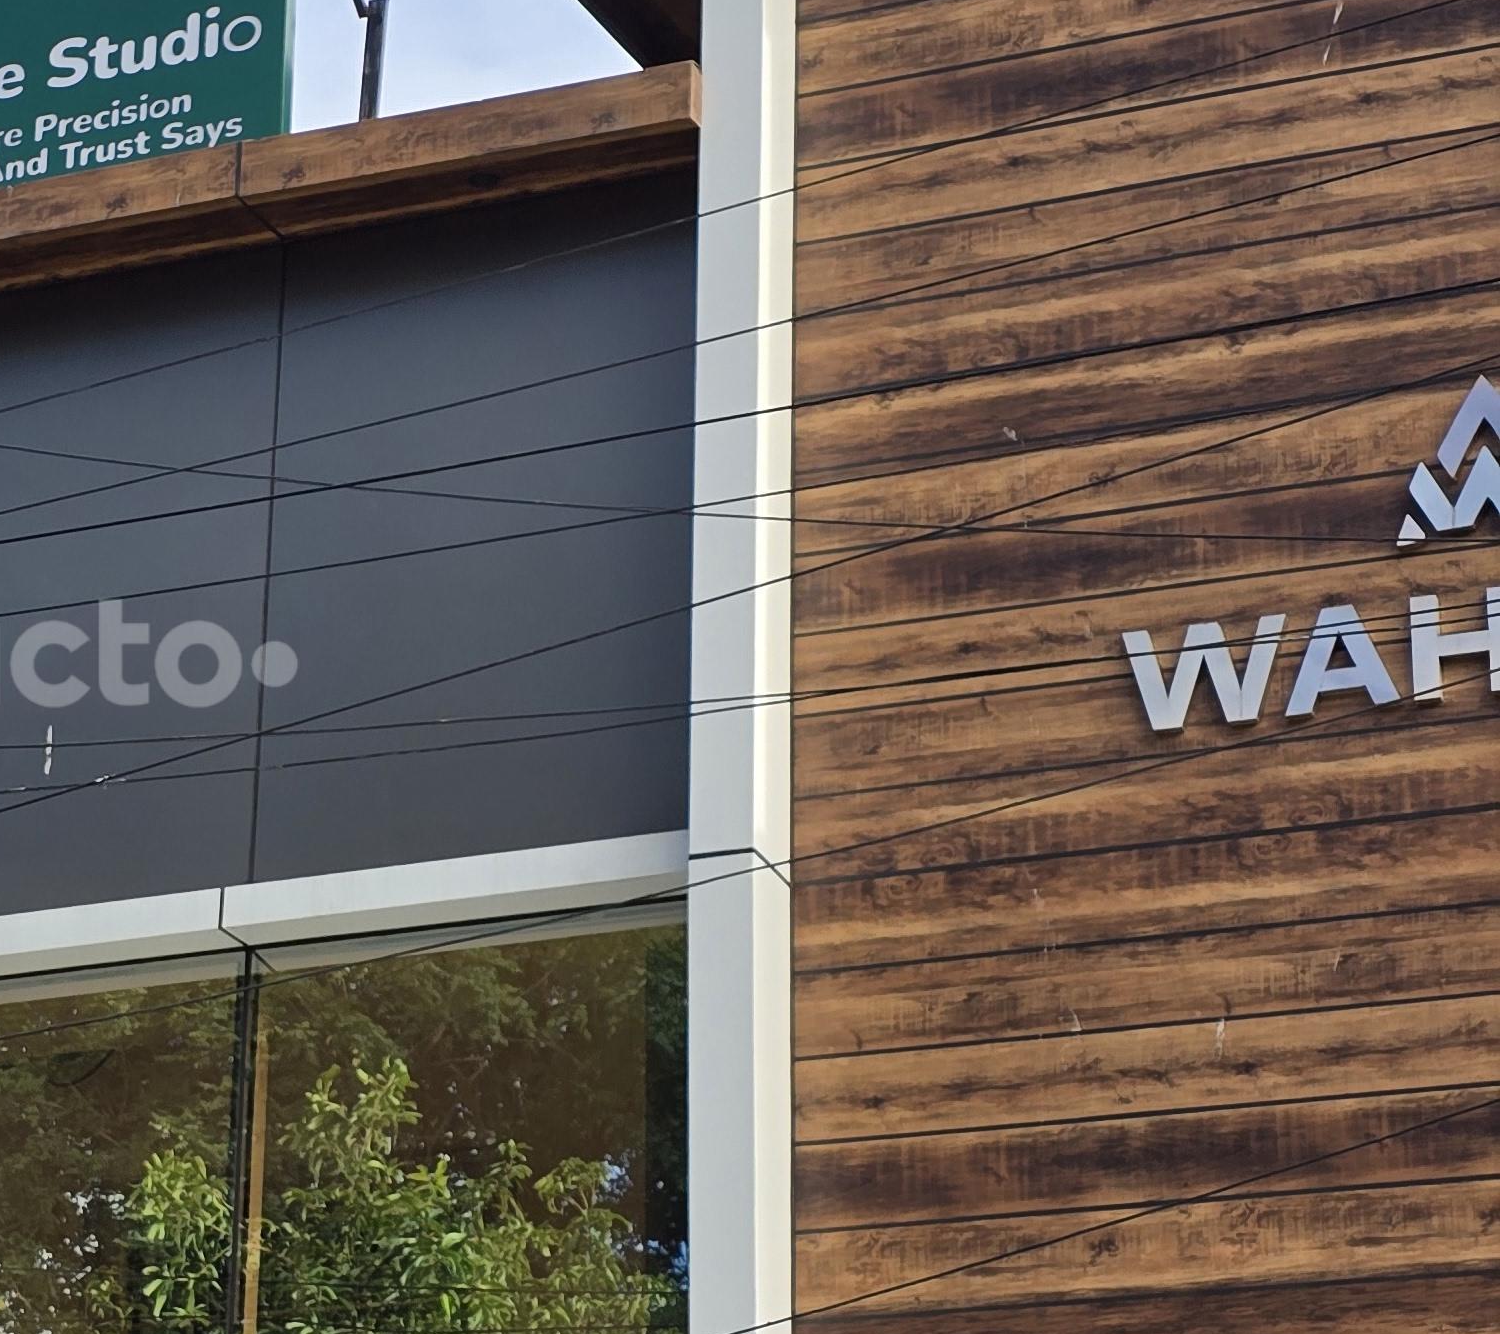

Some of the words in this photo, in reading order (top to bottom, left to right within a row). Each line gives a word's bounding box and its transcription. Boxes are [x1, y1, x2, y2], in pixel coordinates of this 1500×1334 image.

[46, 6, 263, 88] Studio
[34, 93, 192, 142] Precision
[58, 130, 151, 169] Trust
[160, 116, 243, 150] Says
